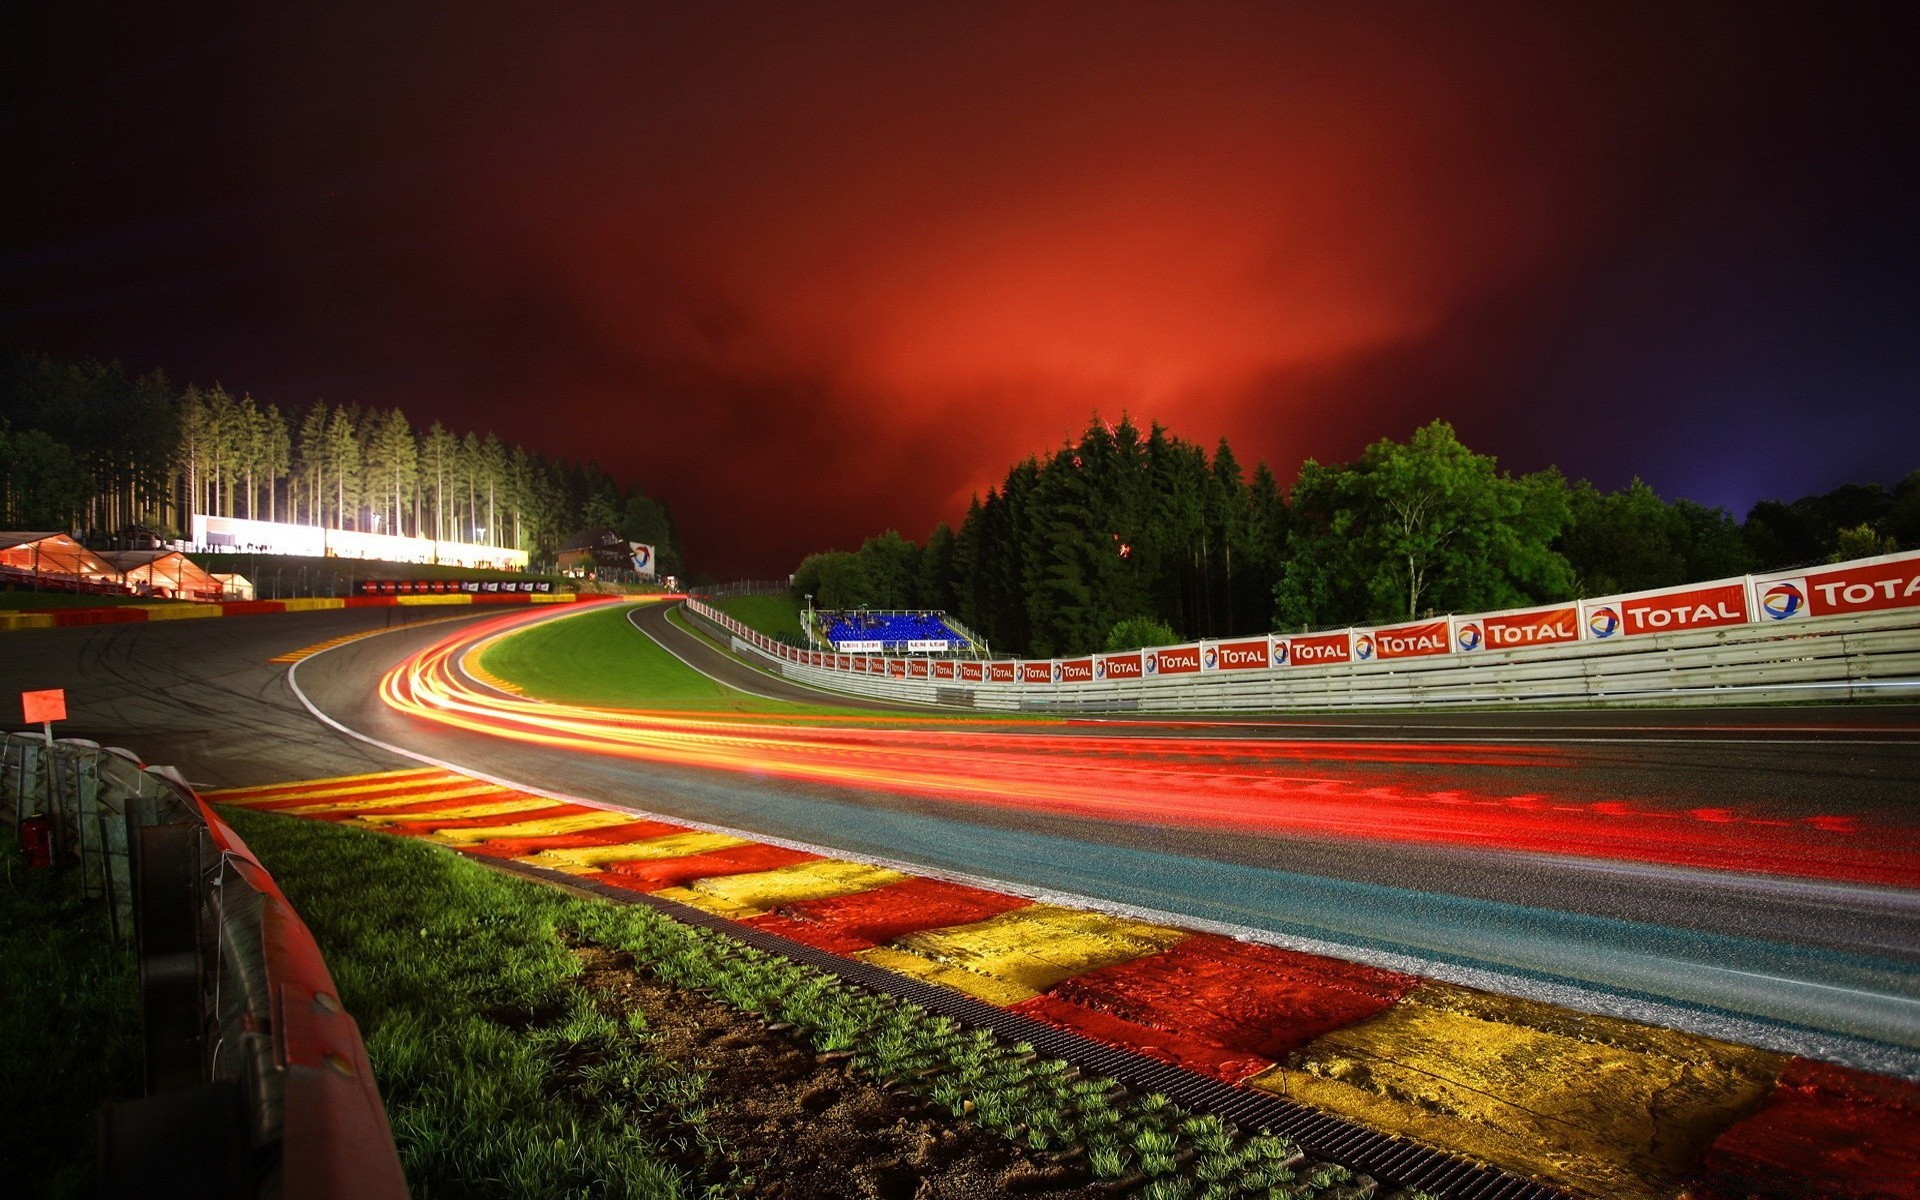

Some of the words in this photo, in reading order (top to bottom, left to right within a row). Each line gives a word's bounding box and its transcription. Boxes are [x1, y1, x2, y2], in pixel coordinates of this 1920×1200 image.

[1627, 601, 1740, 629] TOTAL
[1487, 622, 1574, 643] TOTAL
[1378, 634, 1446, 653] TOTAL
[1220, 649, 1266, 664] TOTAL
[1292, 643, 1348, 660] TOTAL
[872, 661, 884, 670] TOTAL
[1159, 655, 1198, 668] TOTAL
[891, 663, 904, 672] TOTAL
[912, 663, 927, 672] TOTAL
[936, 665, 953, 674] TOTAL
[963, 667, 981, 677] TOTAL
[992, 667, 1013, 678] TOTAL
[1025, 667, 1050, 679] TOTAL
[1063, 666, 1091, 677] TOTAL
[1107, 662, 1140, 673] TOTAL
